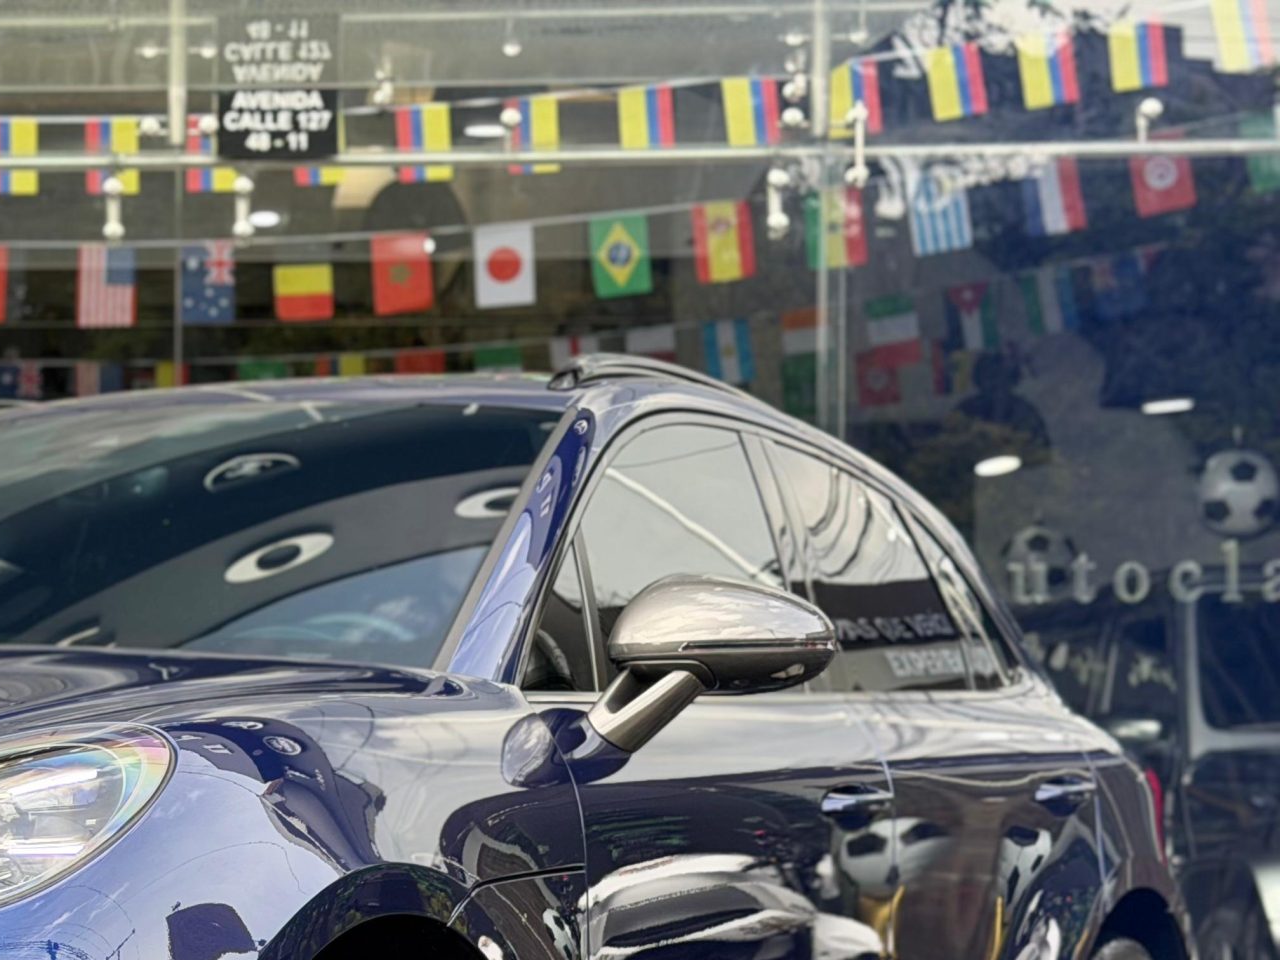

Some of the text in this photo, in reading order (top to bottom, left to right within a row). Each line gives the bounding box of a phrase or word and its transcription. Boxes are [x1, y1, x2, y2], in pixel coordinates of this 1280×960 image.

[231, 90, 324, 110] AVENIDA
[223, 110, 332, 131] CALLE 127
[1007, 538, 1280, 604] utocla
